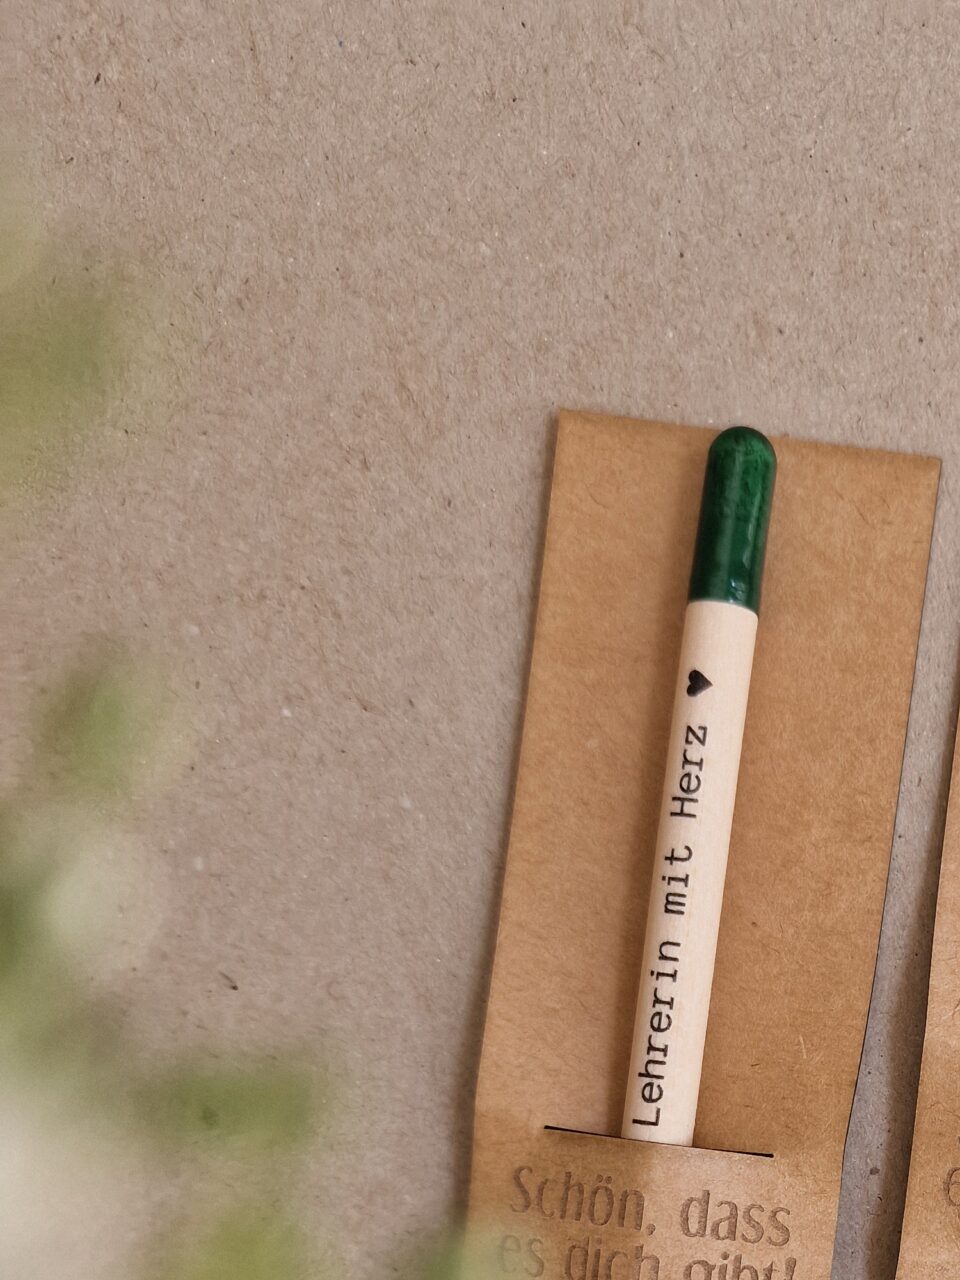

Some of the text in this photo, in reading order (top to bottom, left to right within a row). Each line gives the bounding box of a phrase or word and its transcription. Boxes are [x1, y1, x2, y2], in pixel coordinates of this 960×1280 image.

[632, 724, 708, 1128] Lehrerin mit Herz
[510, 1165, 791, 1247] Schön, dass
[499, 1233, 545, 1278] es
